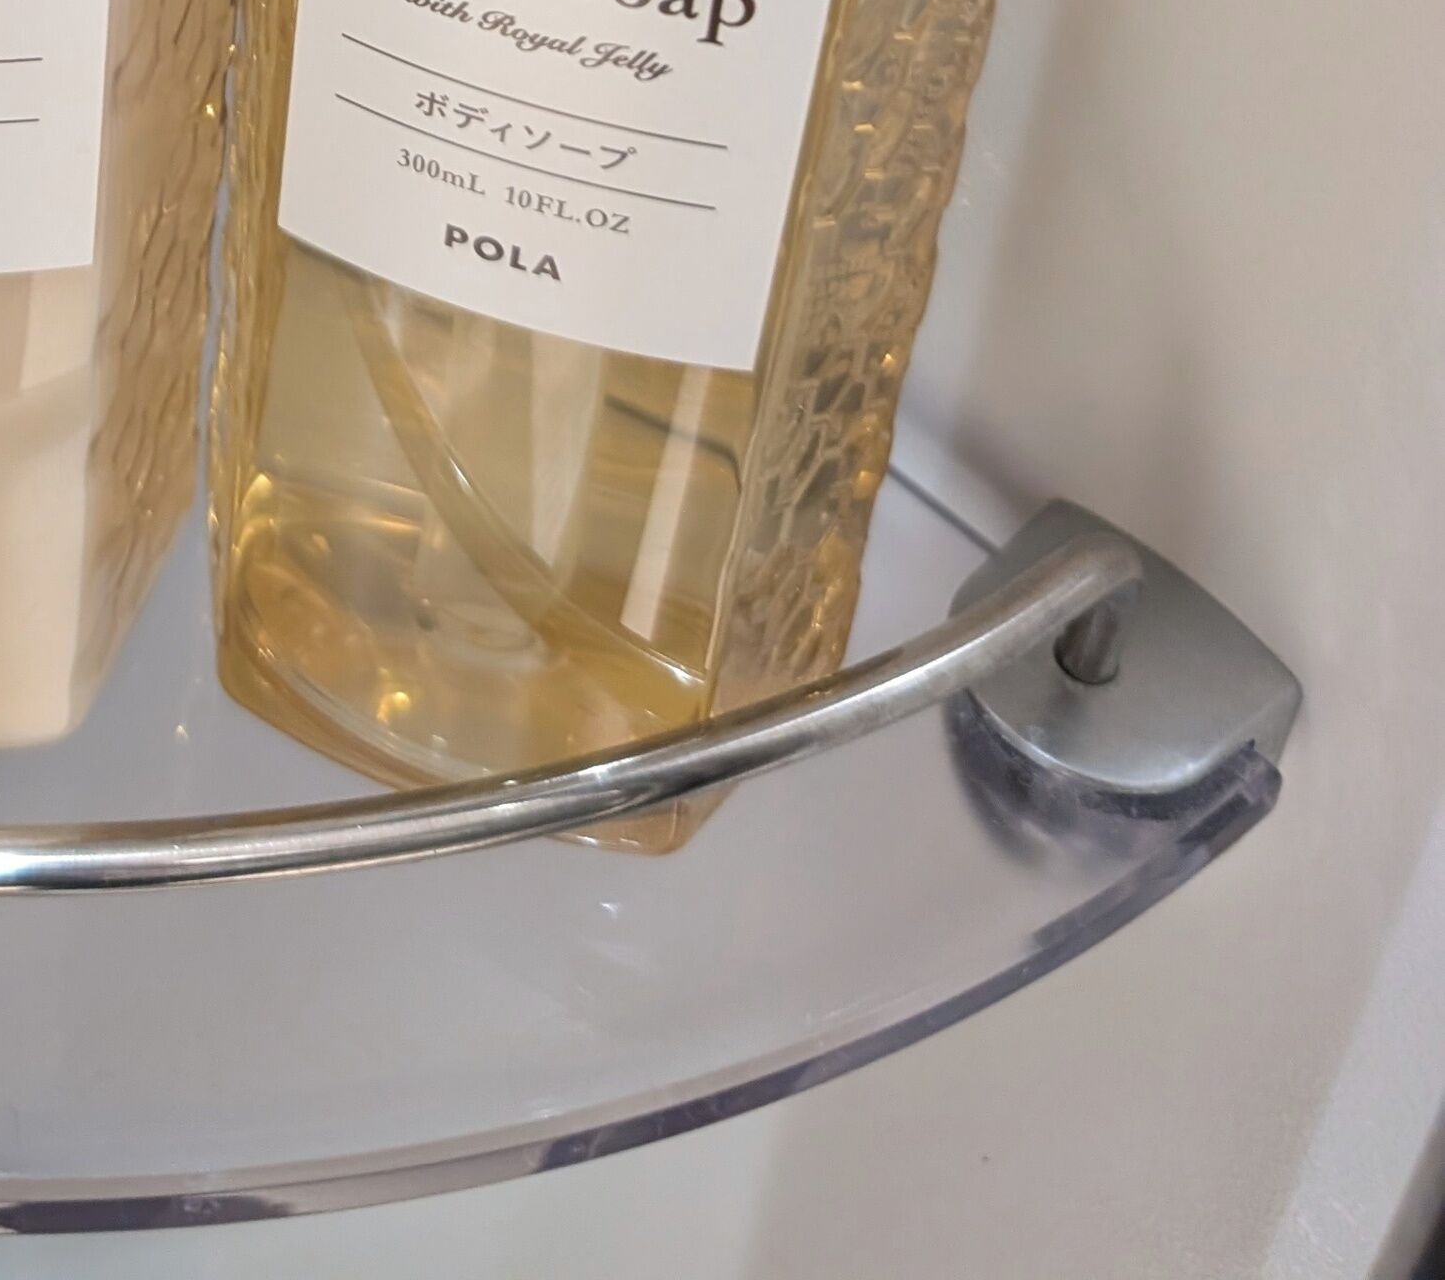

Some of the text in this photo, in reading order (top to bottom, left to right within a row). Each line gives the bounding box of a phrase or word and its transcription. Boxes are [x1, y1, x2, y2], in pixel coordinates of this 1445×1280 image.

[476, 9, 588, 57] Royal
[579, 41, 675, 83] Jelly
[413, 88, 639, 171] ボディソープ
[395, 147, 631, 236] 300mL 10FL.OZ
[442, 222, 563, 283] POLA
